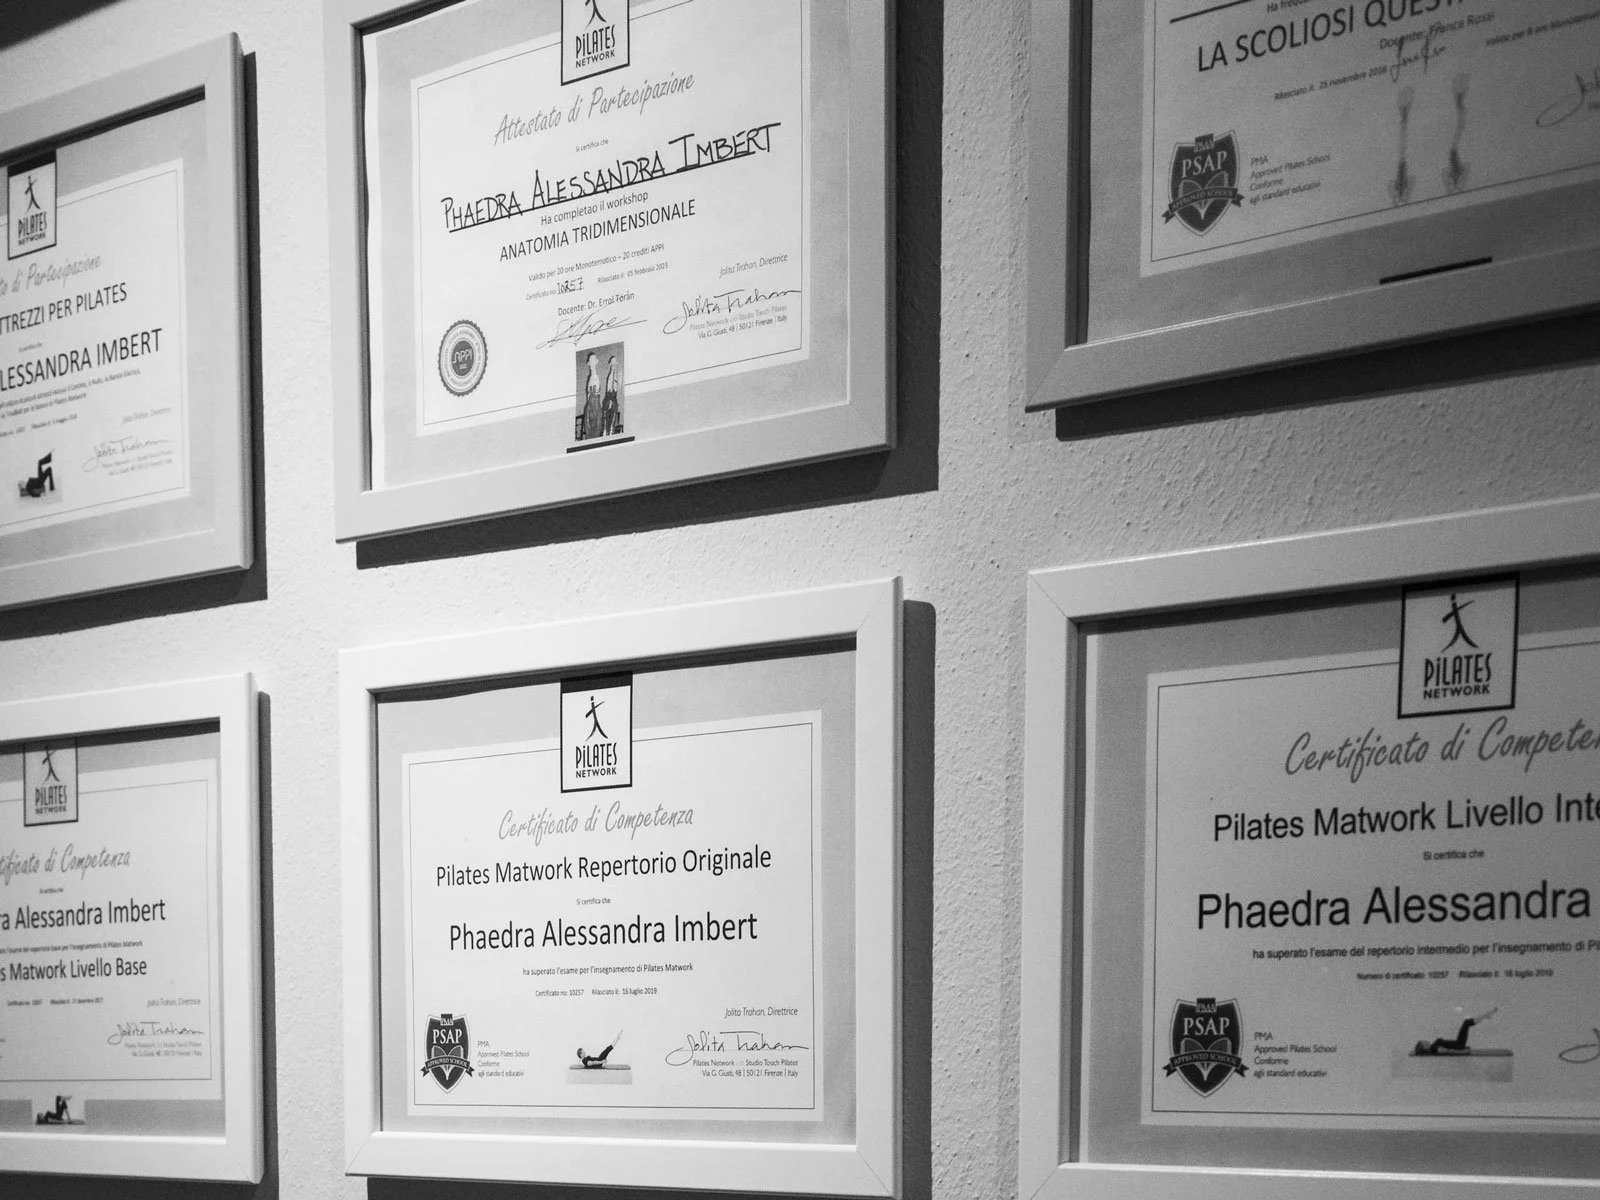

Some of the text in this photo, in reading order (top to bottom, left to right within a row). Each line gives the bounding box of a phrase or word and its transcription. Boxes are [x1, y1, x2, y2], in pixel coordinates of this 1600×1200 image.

[1199, 5, 1354, 72] LA SCOLIOSI
[576, 50, 615, 68] NETWORK
[494, 72, 695, 146] Attestato di Partecipazione
[1181, 150, 1227, 178] PSAP
[440, 121, 781, 230] PHAEDRA ALESSANDRA IMBERT
[540, 191, 648, 226] Ha completao workshop
[500, 199, 696, 262] ANATOMIA TRIDIMENSIONALE
[575, 256, 617, 272] Monotematico
[759, 254, 788, 267] Direttrice
[49, 298, 73, 322] PER
[76, 282, 128, 314] PILATES
[558, 304, 586, 316] Docente:
[96, 328, 163, 367] IMBERT
[1423, 683, 1490, 700] NETWORK
[1285, 726, 1429, 784] Certificato
[1440, 722, 1471, 762] di
[575, 767, 617, 778] NETWORK
[498, 800, 694, 847] Certificato di Competenza
[1214, 792, 1600, 842] Pilates Matwork Livello Int
[44, 842, 131, 881] di Competenza
[1433, 850, 1467, 860] certifica
[437, 844, 771, 887] Pilates Matwork Repertorio Originale
[14, 897, 166, 931] Alessandra Imbert
[1198, 879, 1591, 930] Phaedra Alessandra
[450, 911, 758, 950] Phaedra Alessandra Imbert
[1252, 949, 1265, 959] ha
[1267, 948, 1308, 960] superato
[1309, 947, 1347, 958] l'esame
[1367, 944, 1414, 959] repertorio
[1417, 942, 1470, 956] intermedio
[10, 956, 148, 981] Matwork Livello Base
[531, 963, 693, 977] superato Pilates Matwork
[724, 1006, 798, 1019] Jolita Direttrice
[1183, 1016, 1230, 1036] PSAP
[432, 1029, 462, 1044] PSAP
[477, 1040, 490, 1048] PMA
[1254, 1032, 1274, 1041] PMA
[1254, 1044, 1337, 1054] Approved School
[477, 1060, 500, 1068] Conforme
[1254, 1057, 1289, 1065] Conforme
[486, 1069, 504, 1077] standard
[1267, 1068, 1296, 1078] standard
